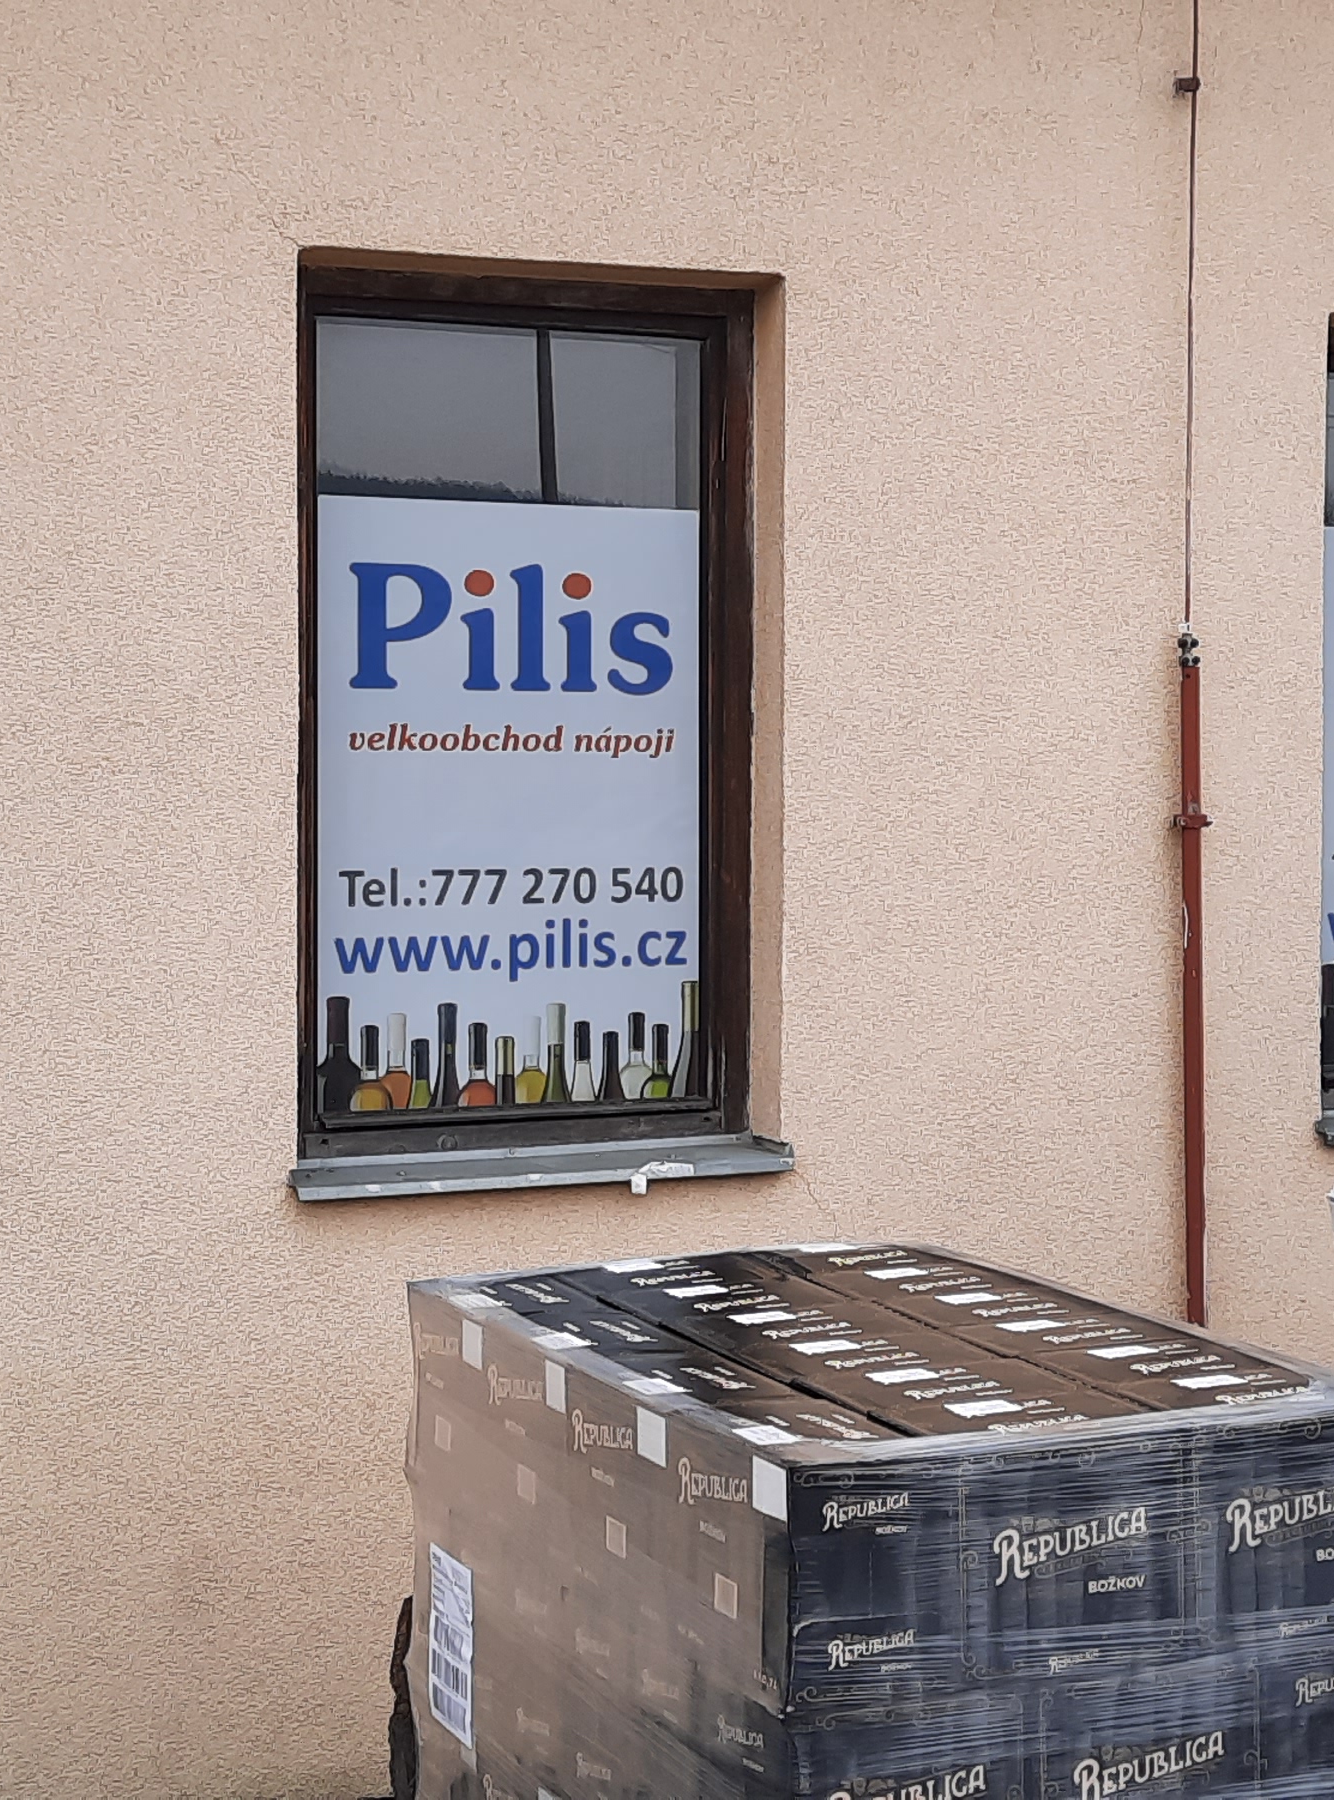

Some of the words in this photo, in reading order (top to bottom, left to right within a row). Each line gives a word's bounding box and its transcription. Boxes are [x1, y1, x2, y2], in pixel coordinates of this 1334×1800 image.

[349, 562, 673, 696] Pilis
[348, 723, 563, 753] velkoobchod
[574, 727, 674, 758] nápoji
[338, 869, 508, 908] Tel.:777
[522, 867, 598, 905] 270
[610, 866, 684, 904] 540
[334, 918, 689, 981] www.pilis.cz
[572, 1408, 633, 1454] REPUBLICA
[678, 1457, 748, 1505] REPUBLICA
[822, 1492, 910, 1532] REPUBLICA
[993, 1506, 1148, 1586] REPUBLICA
[1088, 1575, 1146, 1594] BOŽKOV
[828, 1628, 916, 1671] REPUBLICA
[1074, 1731, 1225, 1800] REPUBLICA
